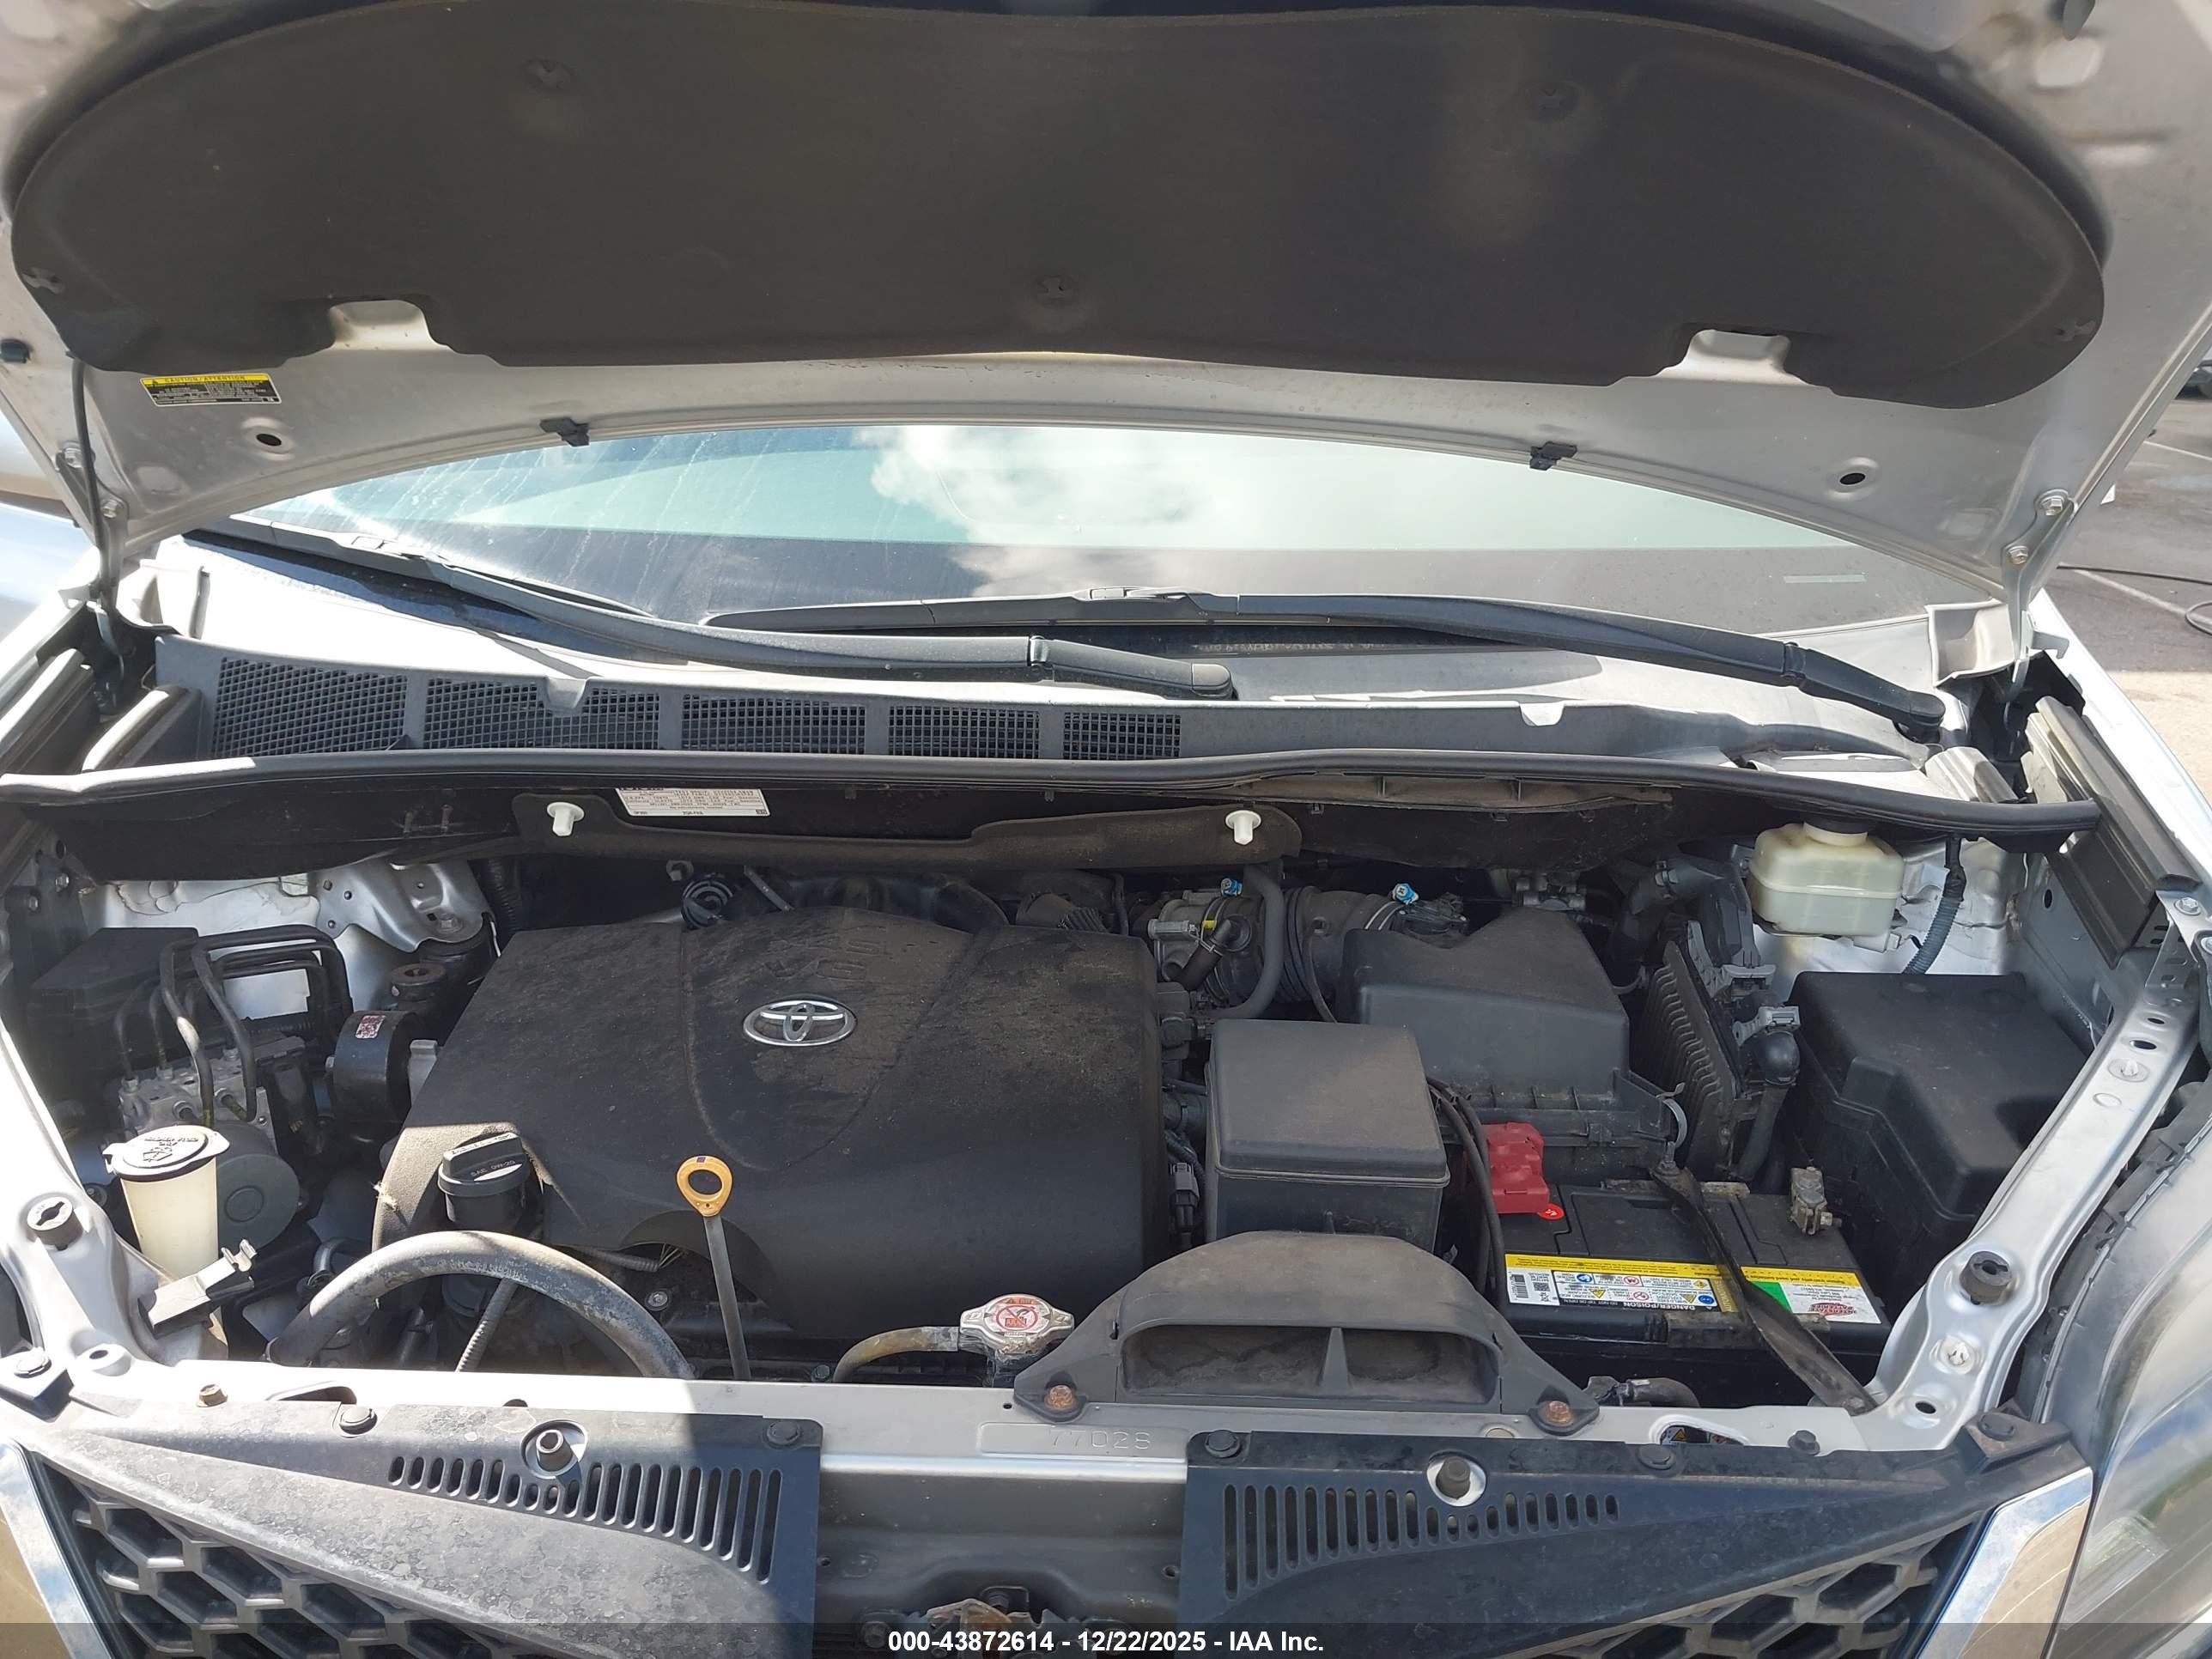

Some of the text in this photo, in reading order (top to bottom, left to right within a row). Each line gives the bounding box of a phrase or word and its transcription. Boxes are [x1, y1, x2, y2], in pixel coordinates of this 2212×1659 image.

[470, 1159, 516, 1177] SAE 0W-20
[1623, 1301, 1696, 1311] DANGER/POISON
